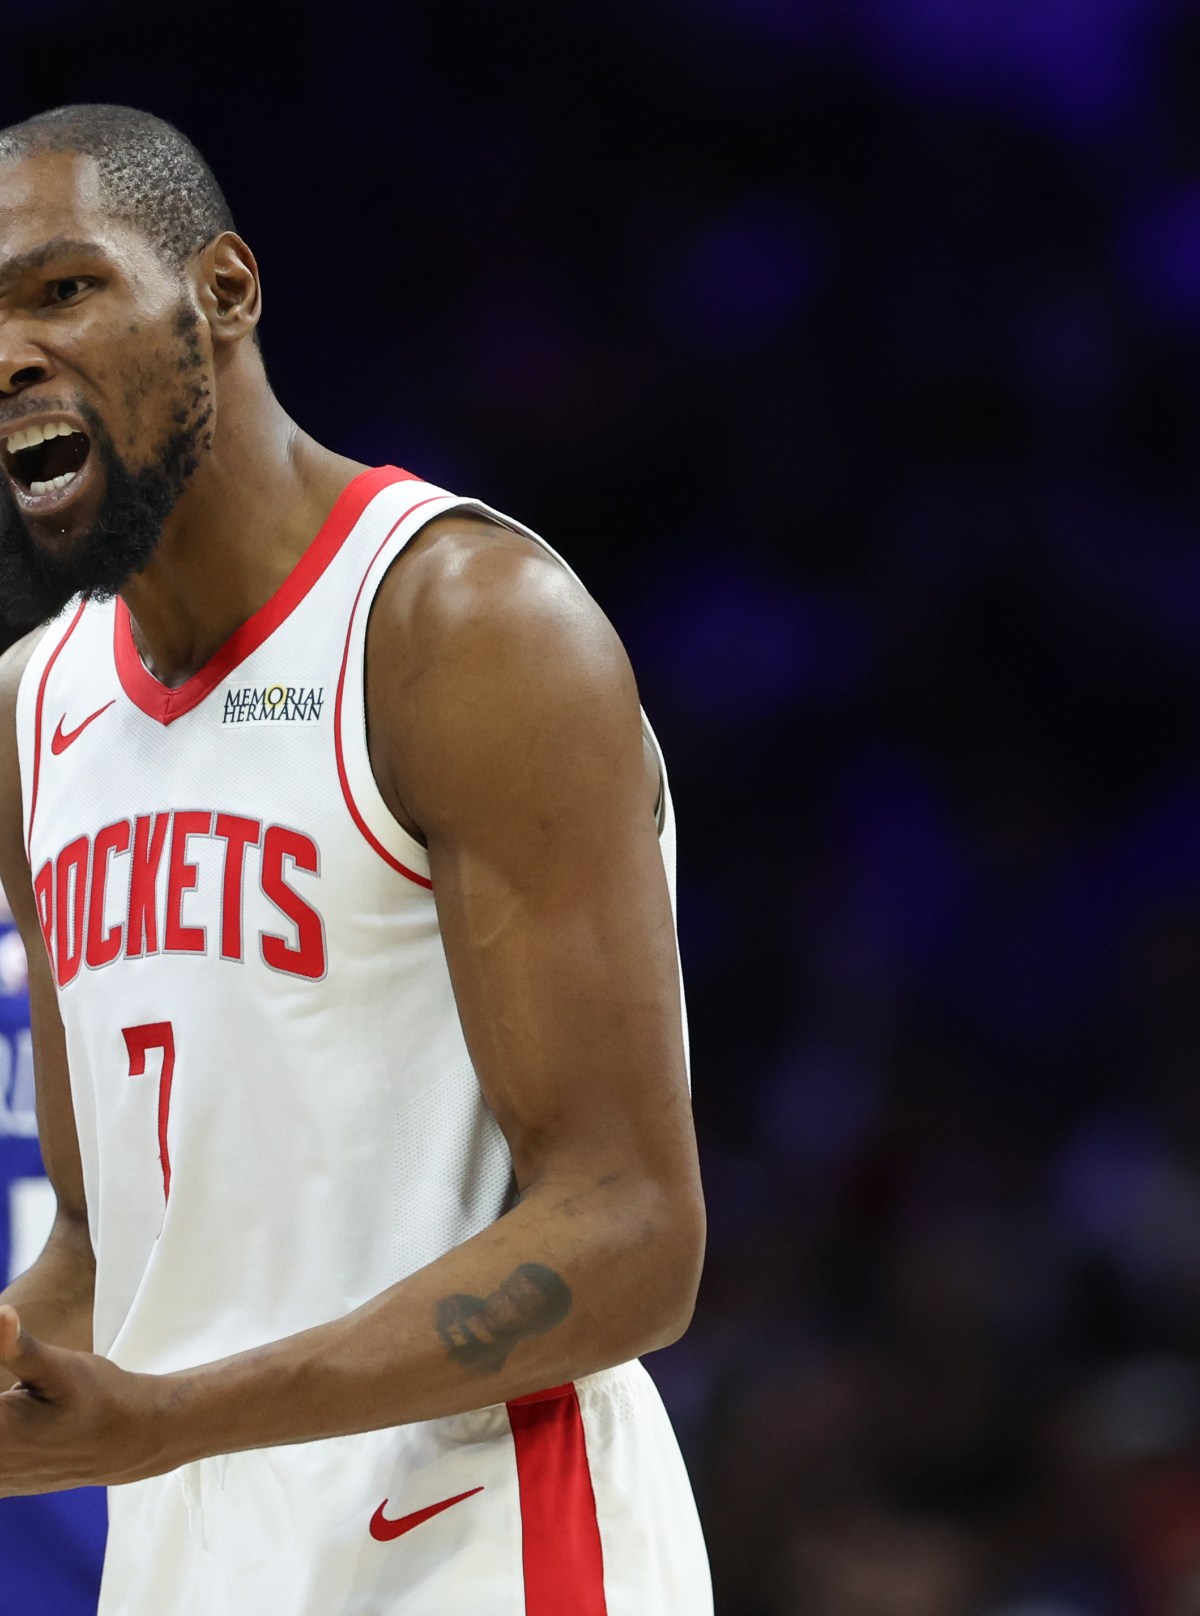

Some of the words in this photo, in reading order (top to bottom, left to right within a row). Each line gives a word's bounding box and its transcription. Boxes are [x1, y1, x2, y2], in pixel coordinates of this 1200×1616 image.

[224, 687, 324, 707] MEMORIAL
[222, 704, 322, 723] HERMANN
[121, 1021, 175, 1212] 7
